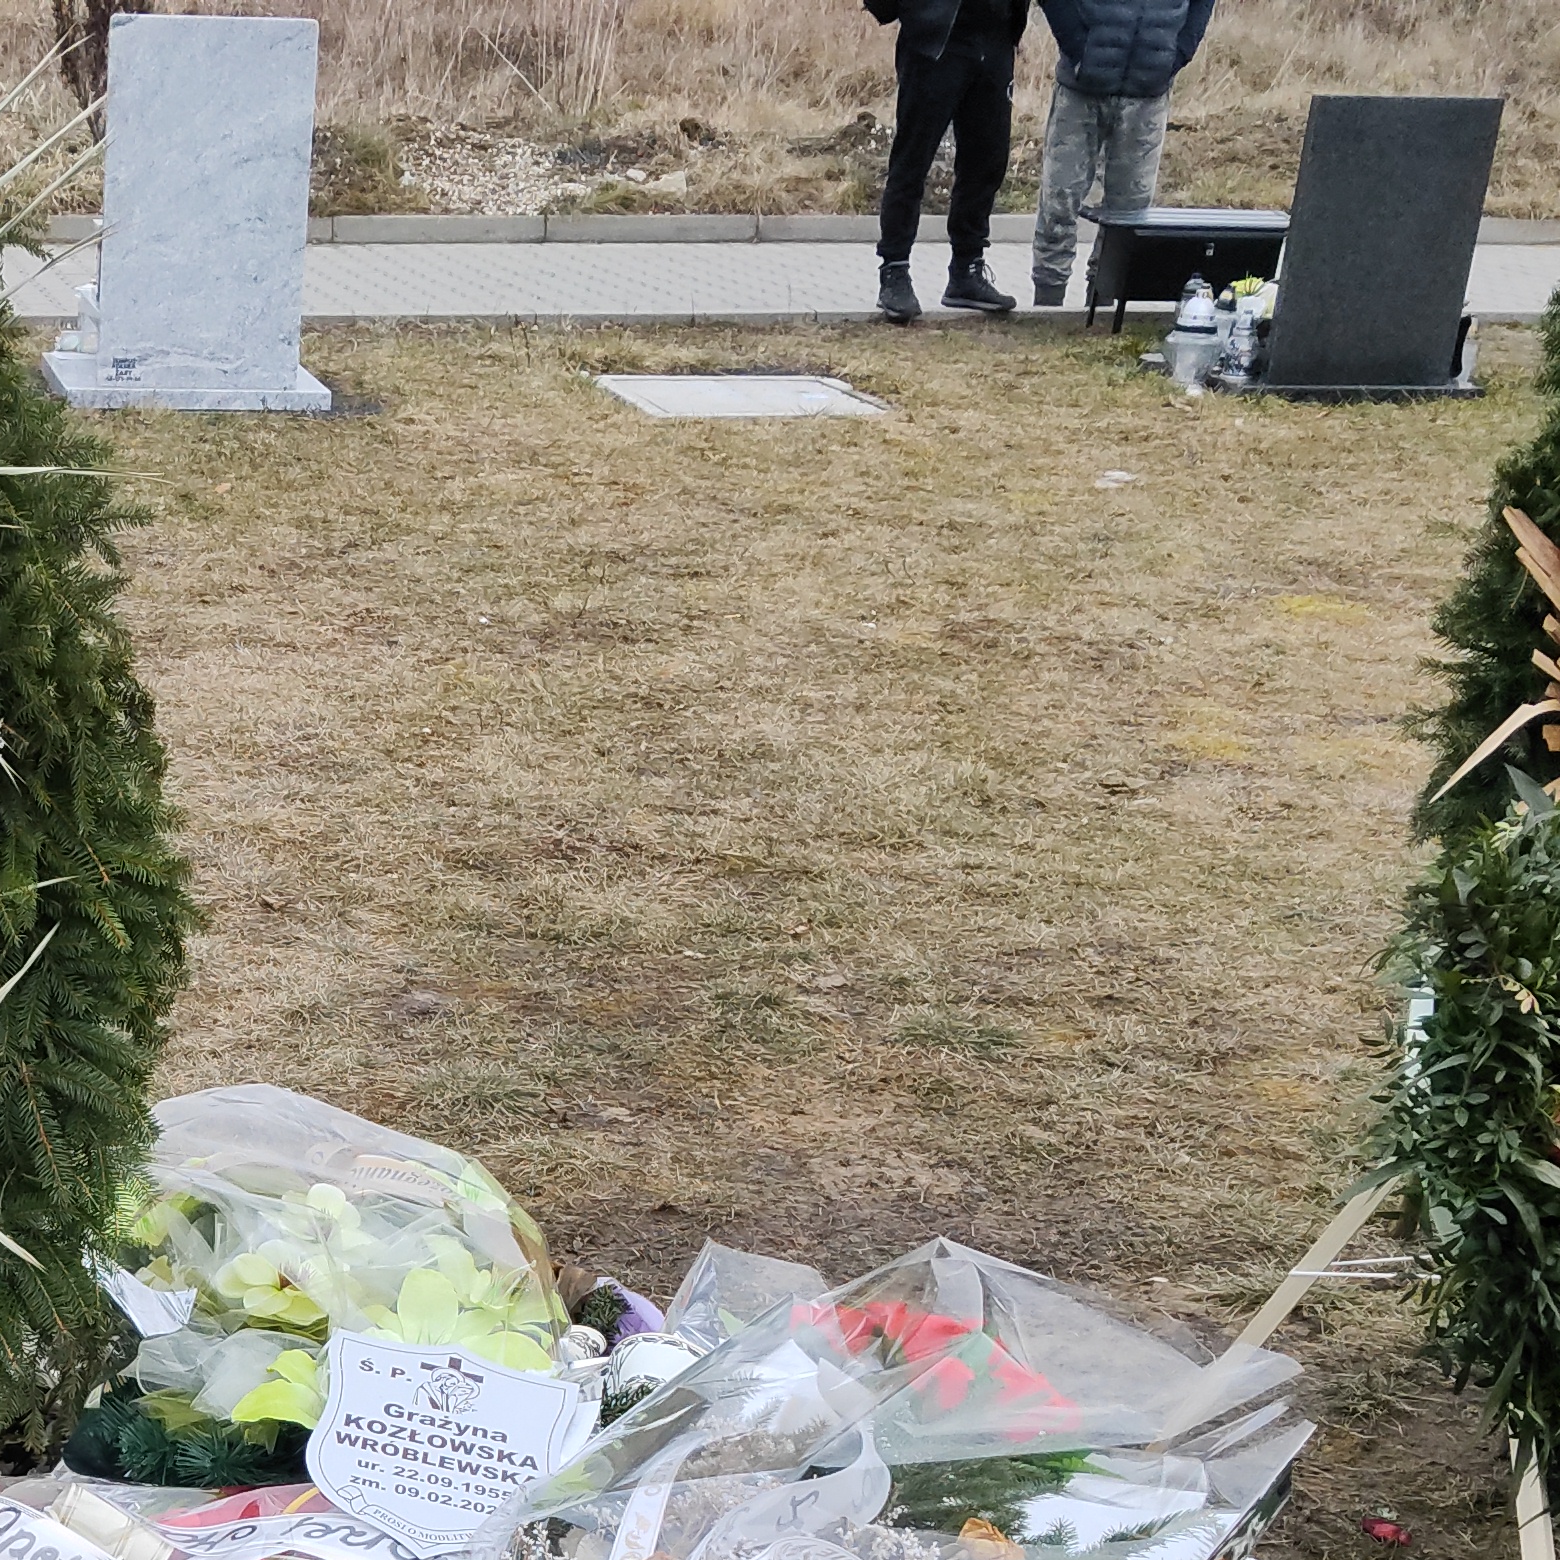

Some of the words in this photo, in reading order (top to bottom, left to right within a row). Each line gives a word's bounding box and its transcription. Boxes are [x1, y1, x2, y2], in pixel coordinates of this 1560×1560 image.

[358, 1357, 382, 1376] Ś.
[390, 1366, 413, 1384] P.
[343, 1412, 540, 1472] KOZŁOWSKA
[383, 1402, 509, 1444] Grażyna
[349, 1475, 387, 1491] zm.
[394, 1485, 498, 1515] 09.02.202
[356, 1459, 386, 1474] ur.
[391, 1466, 512, 1502] 22.09.1955
[372, 1508, 405, 1531] PROSI
[406, 1526, 417, 1536] O
